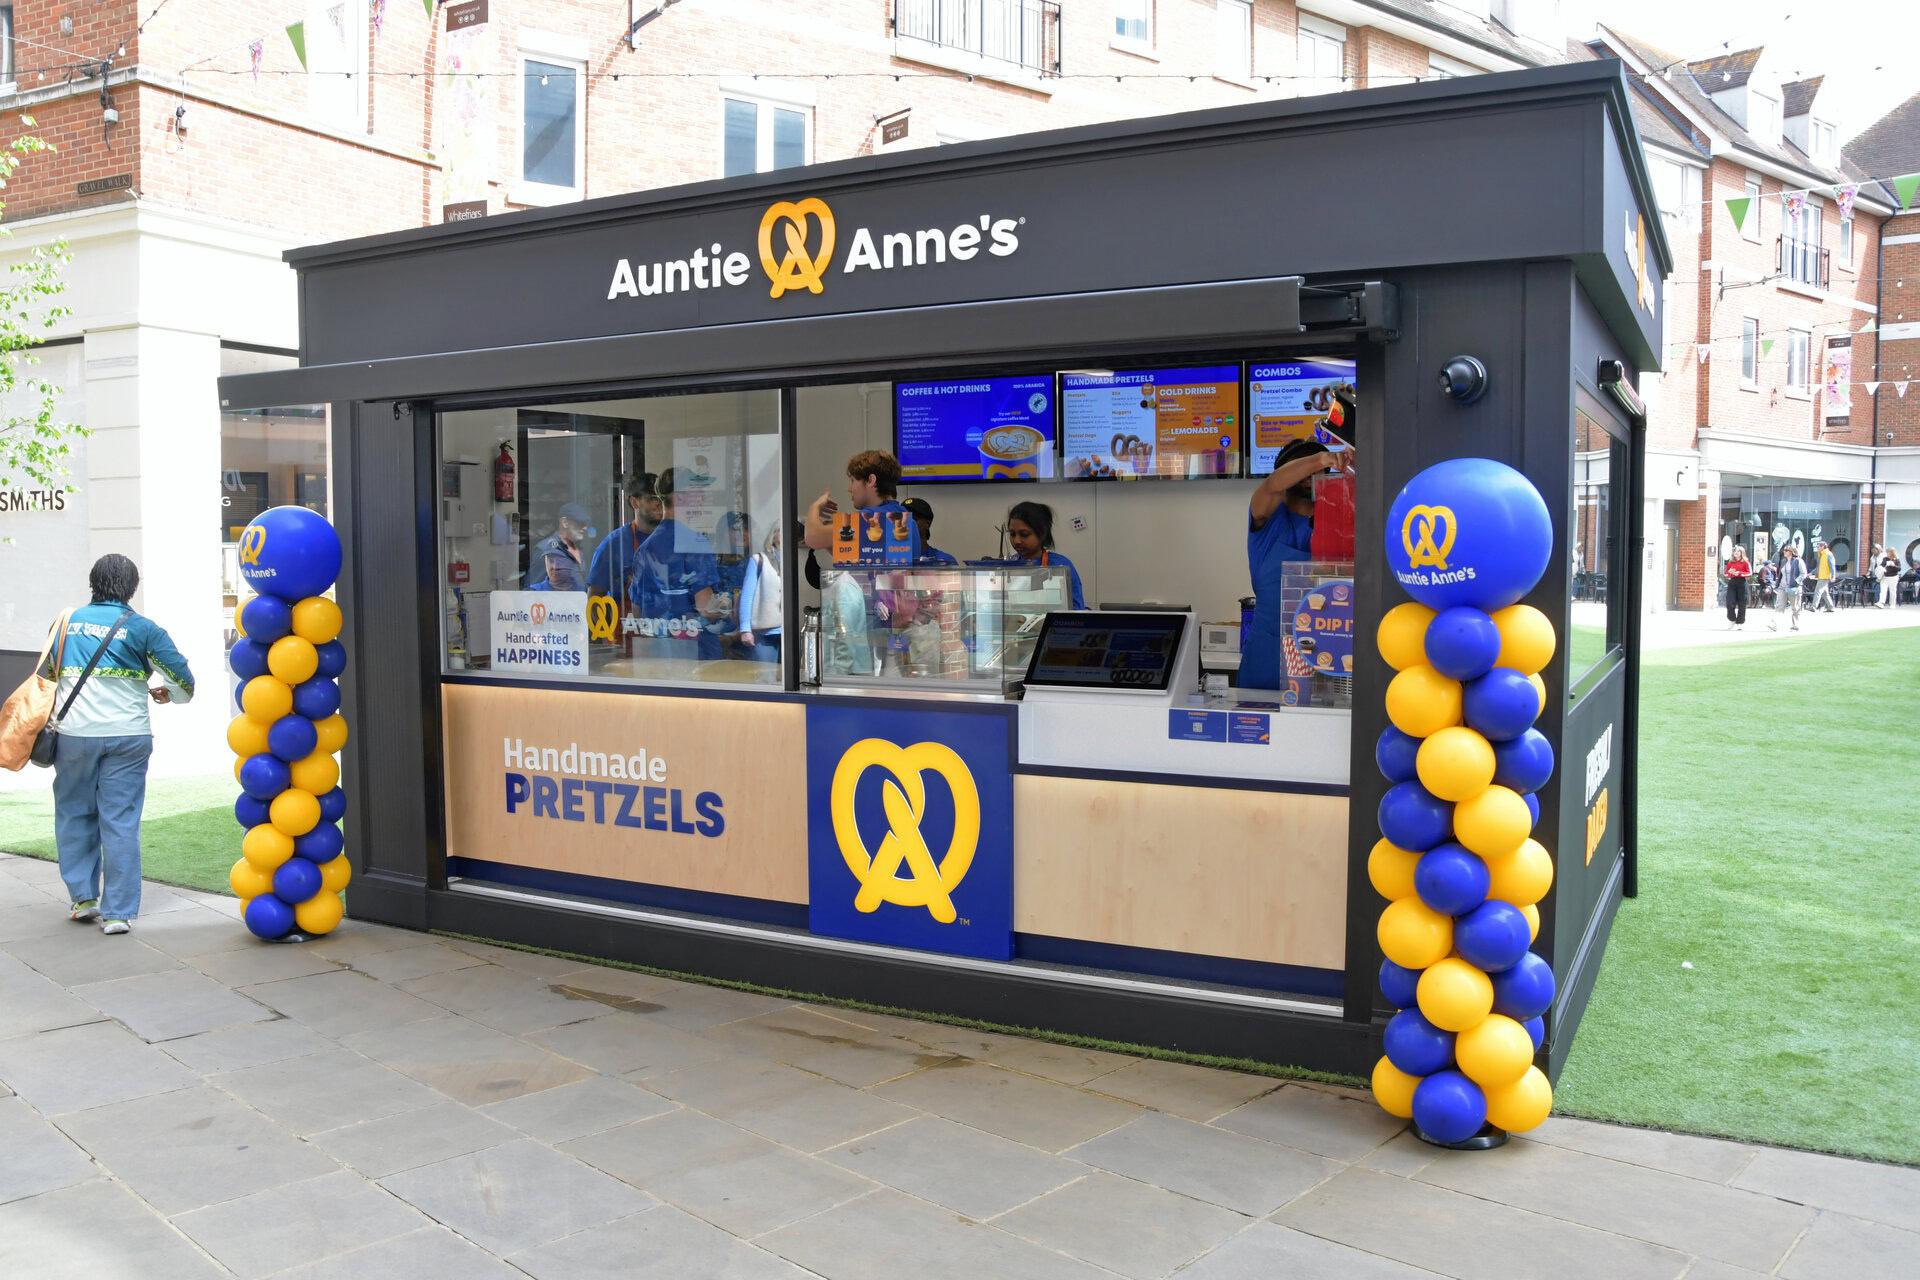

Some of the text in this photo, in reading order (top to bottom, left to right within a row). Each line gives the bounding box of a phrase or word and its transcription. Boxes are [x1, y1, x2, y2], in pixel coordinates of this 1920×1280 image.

[79, 176, 128, 193] GRAVEL WALK
[448, 208, 482, 222] Whitefriars
[607, 242, 751, 301] Auntie
[1255, 367, 1302, 378] COMBOS
[1067, 374, 1154, 386] HANDMADE PRETZELS
[902, 384, 991, 396] COFFEE & HOT DRINKS
[1159, 388, 1184, 396] COLD
[1185, 387, 1216, 395] DRINKS
[1171, 427, 1218, 435] LEMONADES
[250, 567, 278, 578] Anne's
[1431, 566, 1477, 586] Anne's
[497, 610, 580, 623] Auntie Anne's
[1314, 617, 1342, 632] DIP
[506, 631, 569, 646] Handcrafted
[497, 648, 581, 666] HAPPINESS
[504, 738, 668, 782] Handmade
[506, 772, 725, 838] PRETZELS
